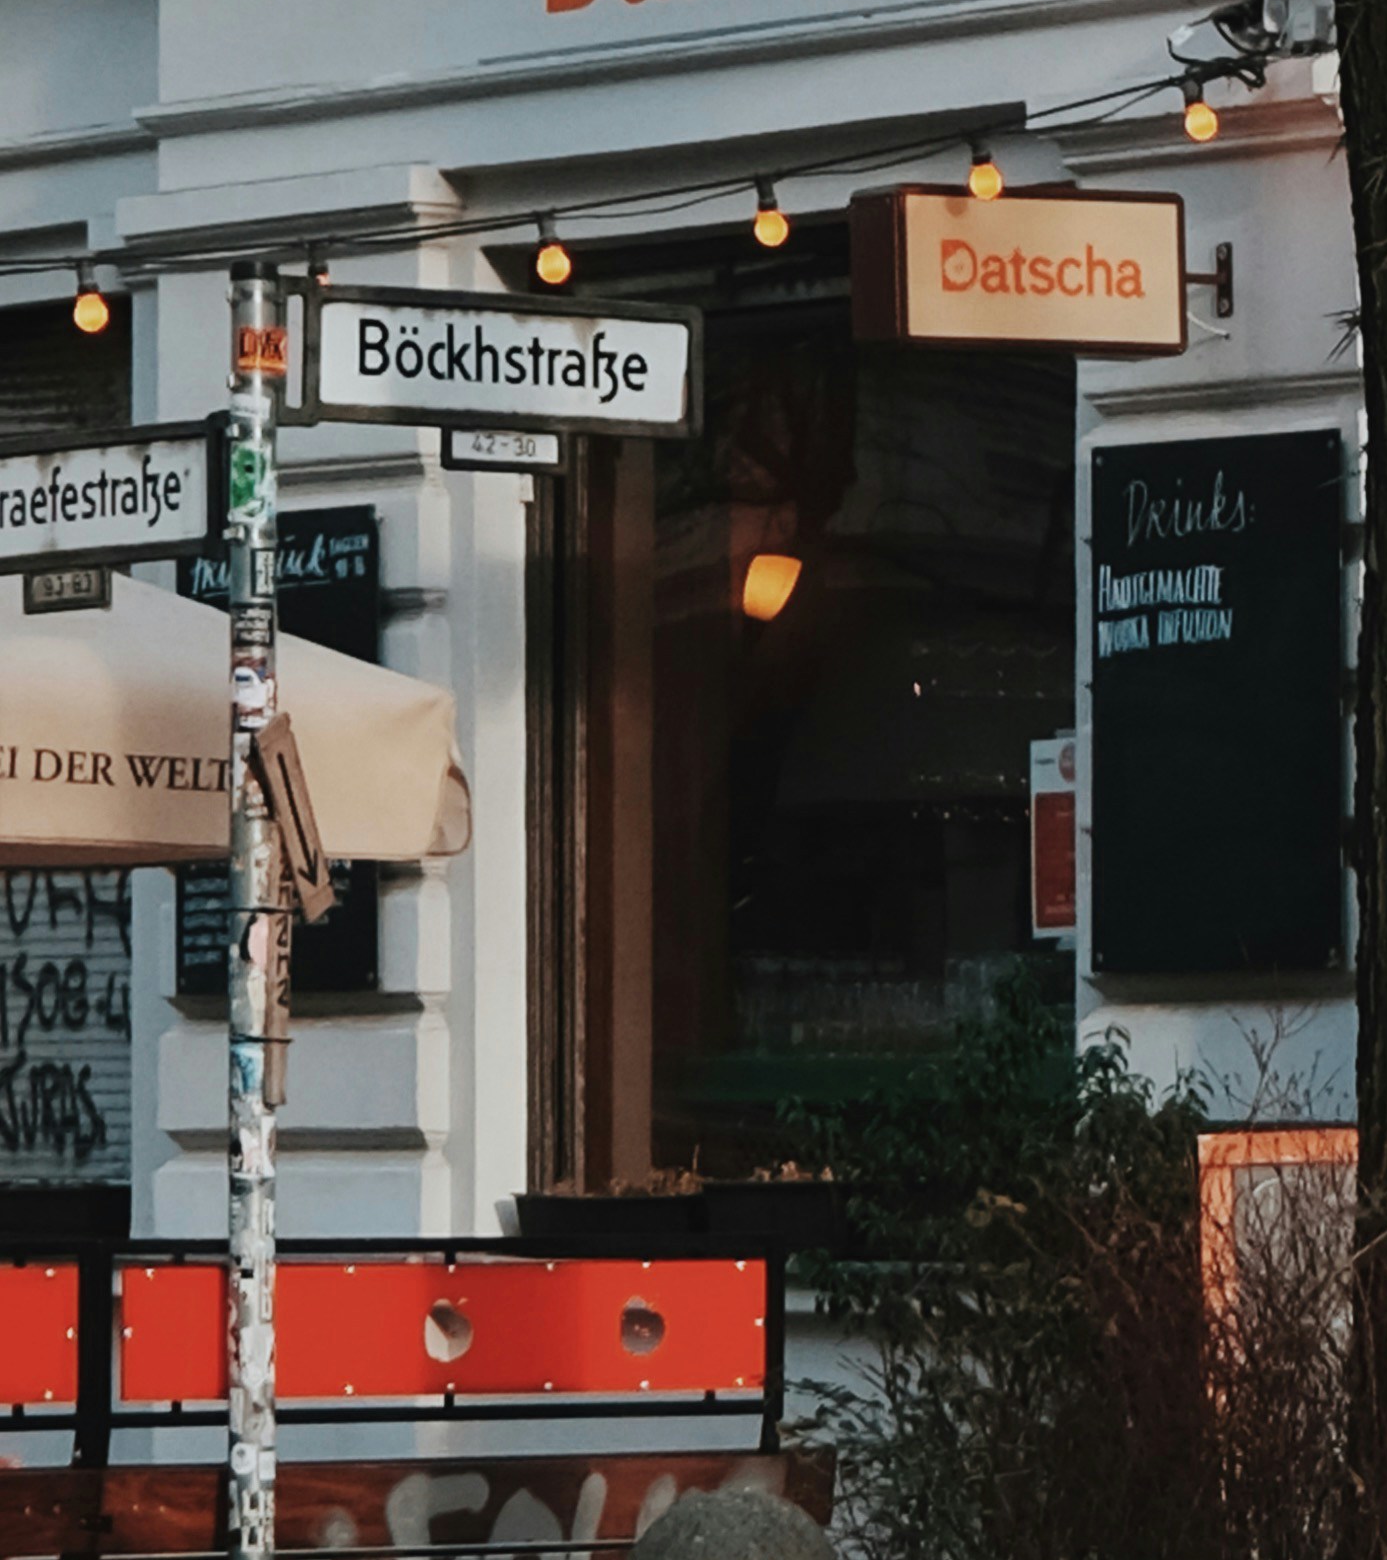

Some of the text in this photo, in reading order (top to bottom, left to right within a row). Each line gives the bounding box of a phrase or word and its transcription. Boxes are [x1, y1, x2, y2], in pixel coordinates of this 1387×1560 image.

[941, 238, 1146, 299] Datscha
[358, 318, 648, 404] Böckhstraße
[32, 749, 115, 787] DER
[125, 754, 230, 793] WELT
